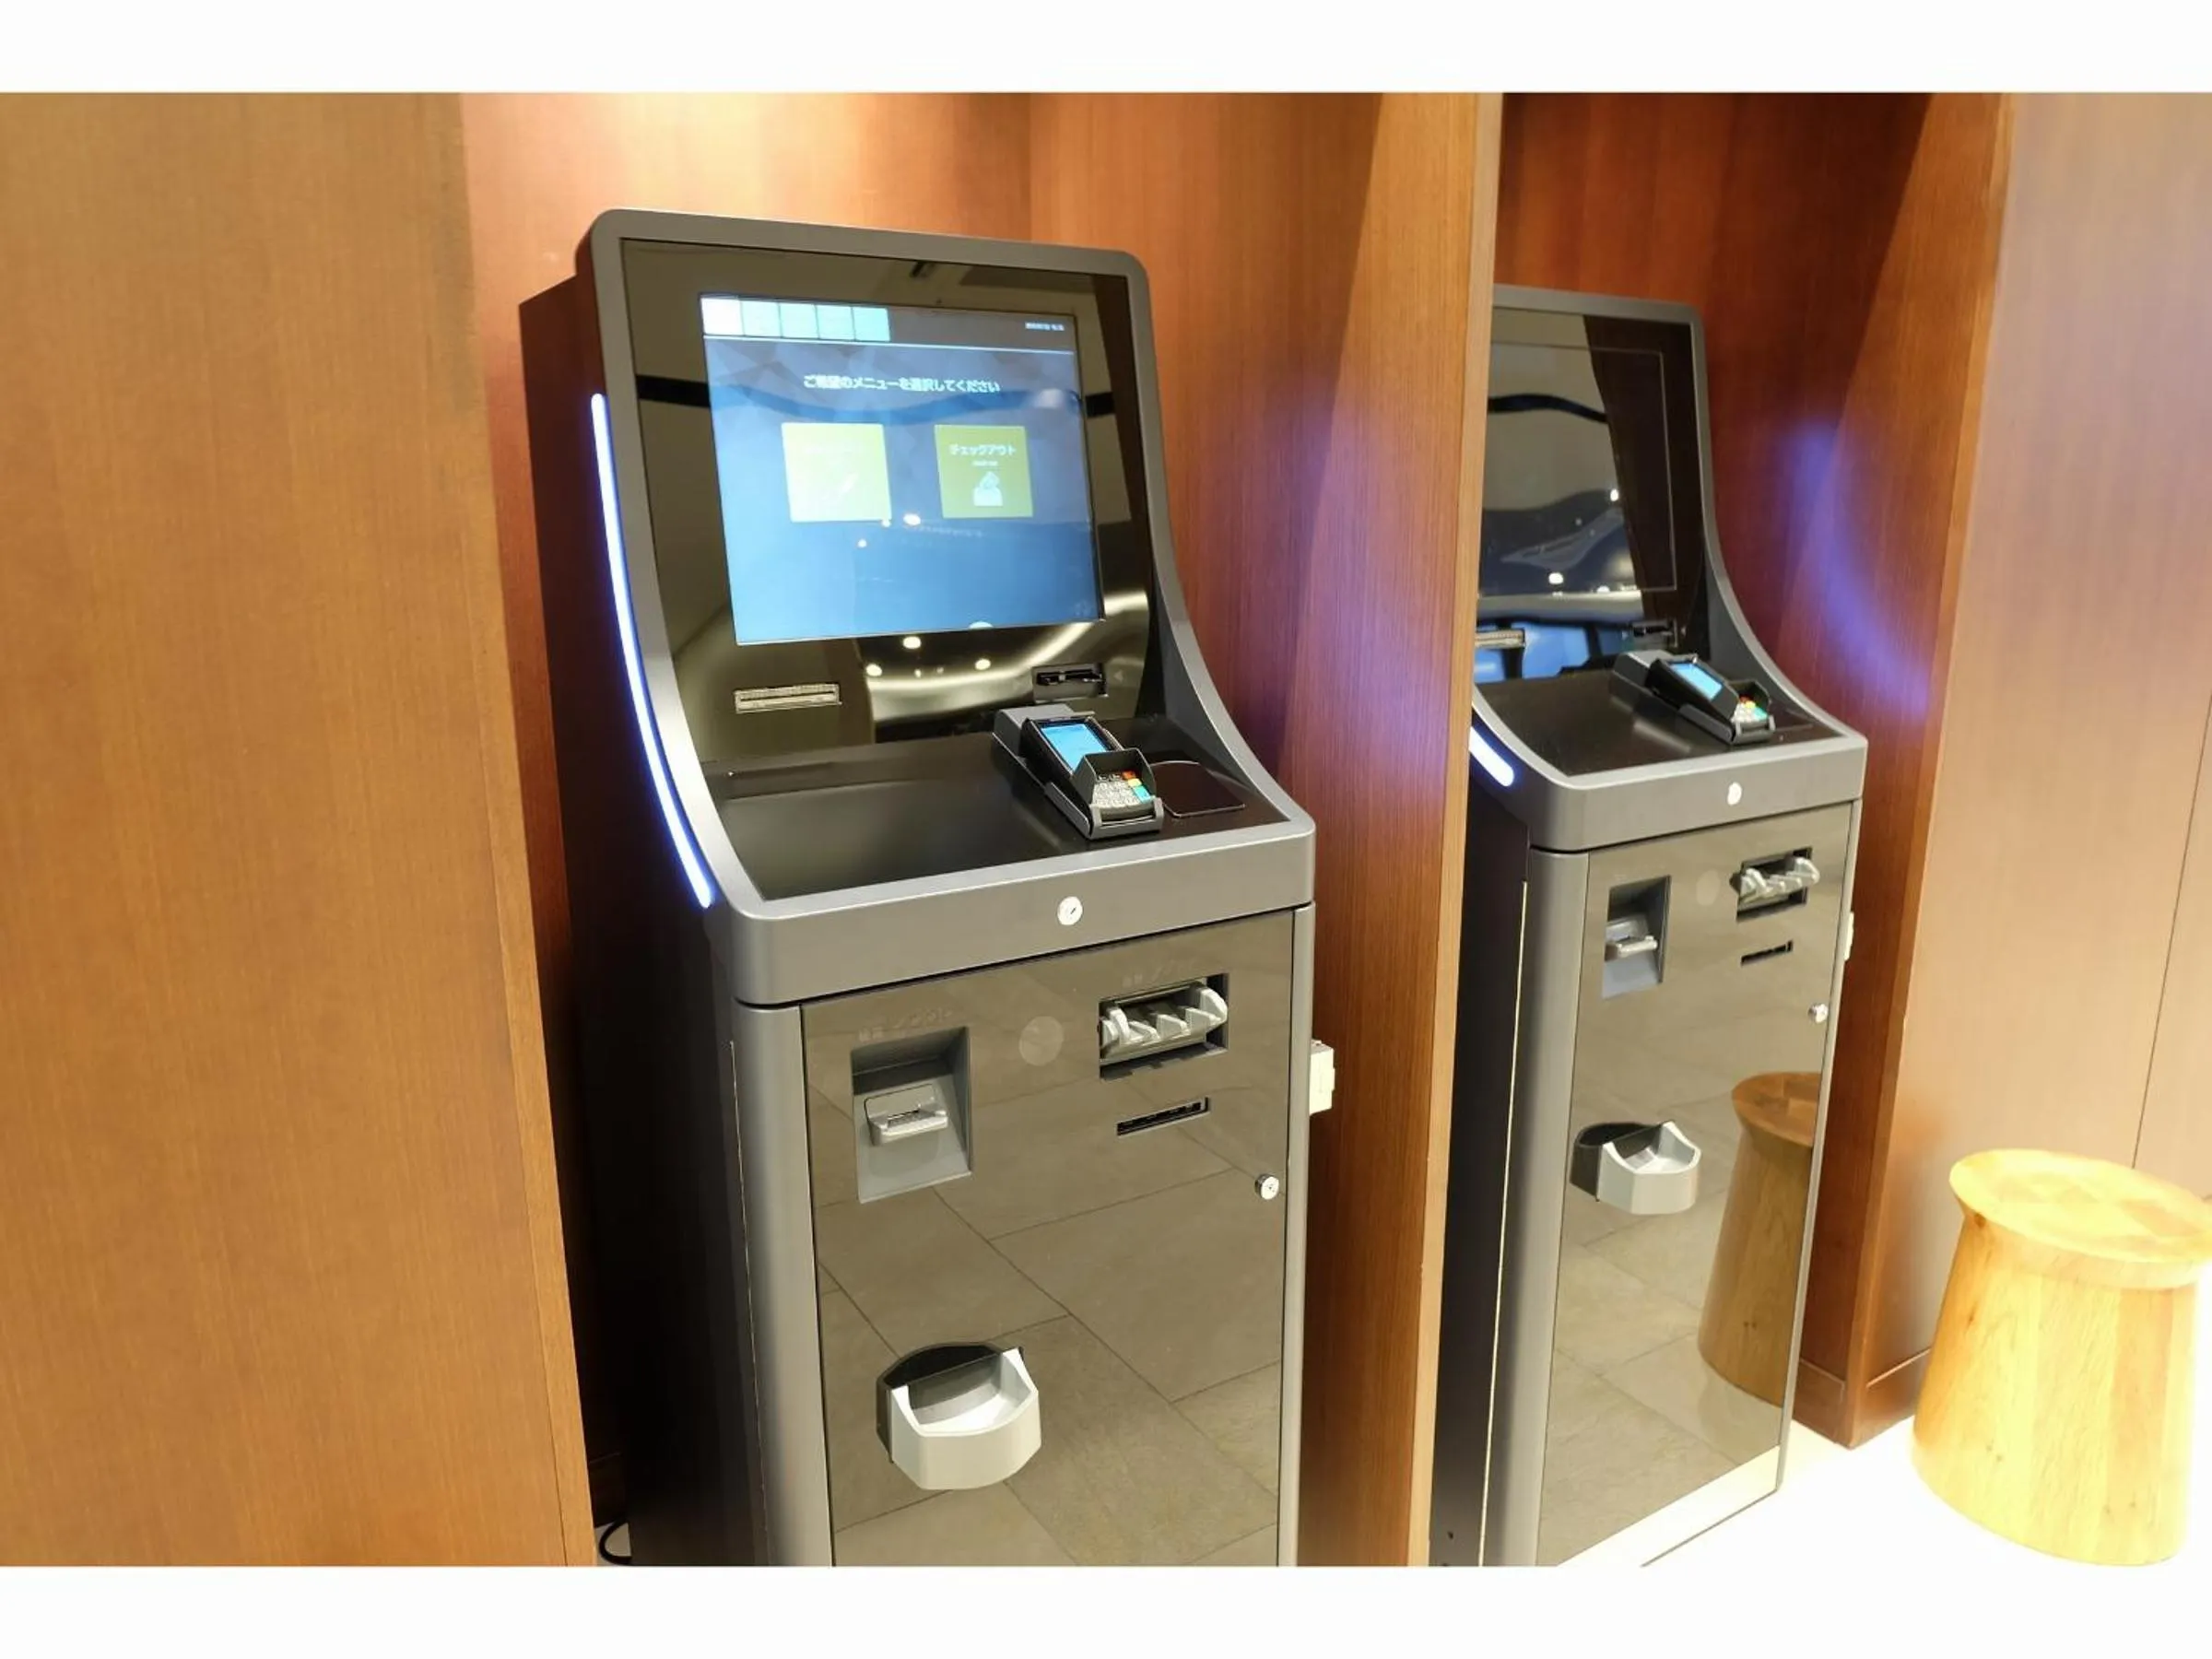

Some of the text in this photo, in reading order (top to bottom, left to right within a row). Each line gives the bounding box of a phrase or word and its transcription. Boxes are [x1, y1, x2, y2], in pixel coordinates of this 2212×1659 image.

[948, 443, 1017, 456] チェックアウト
